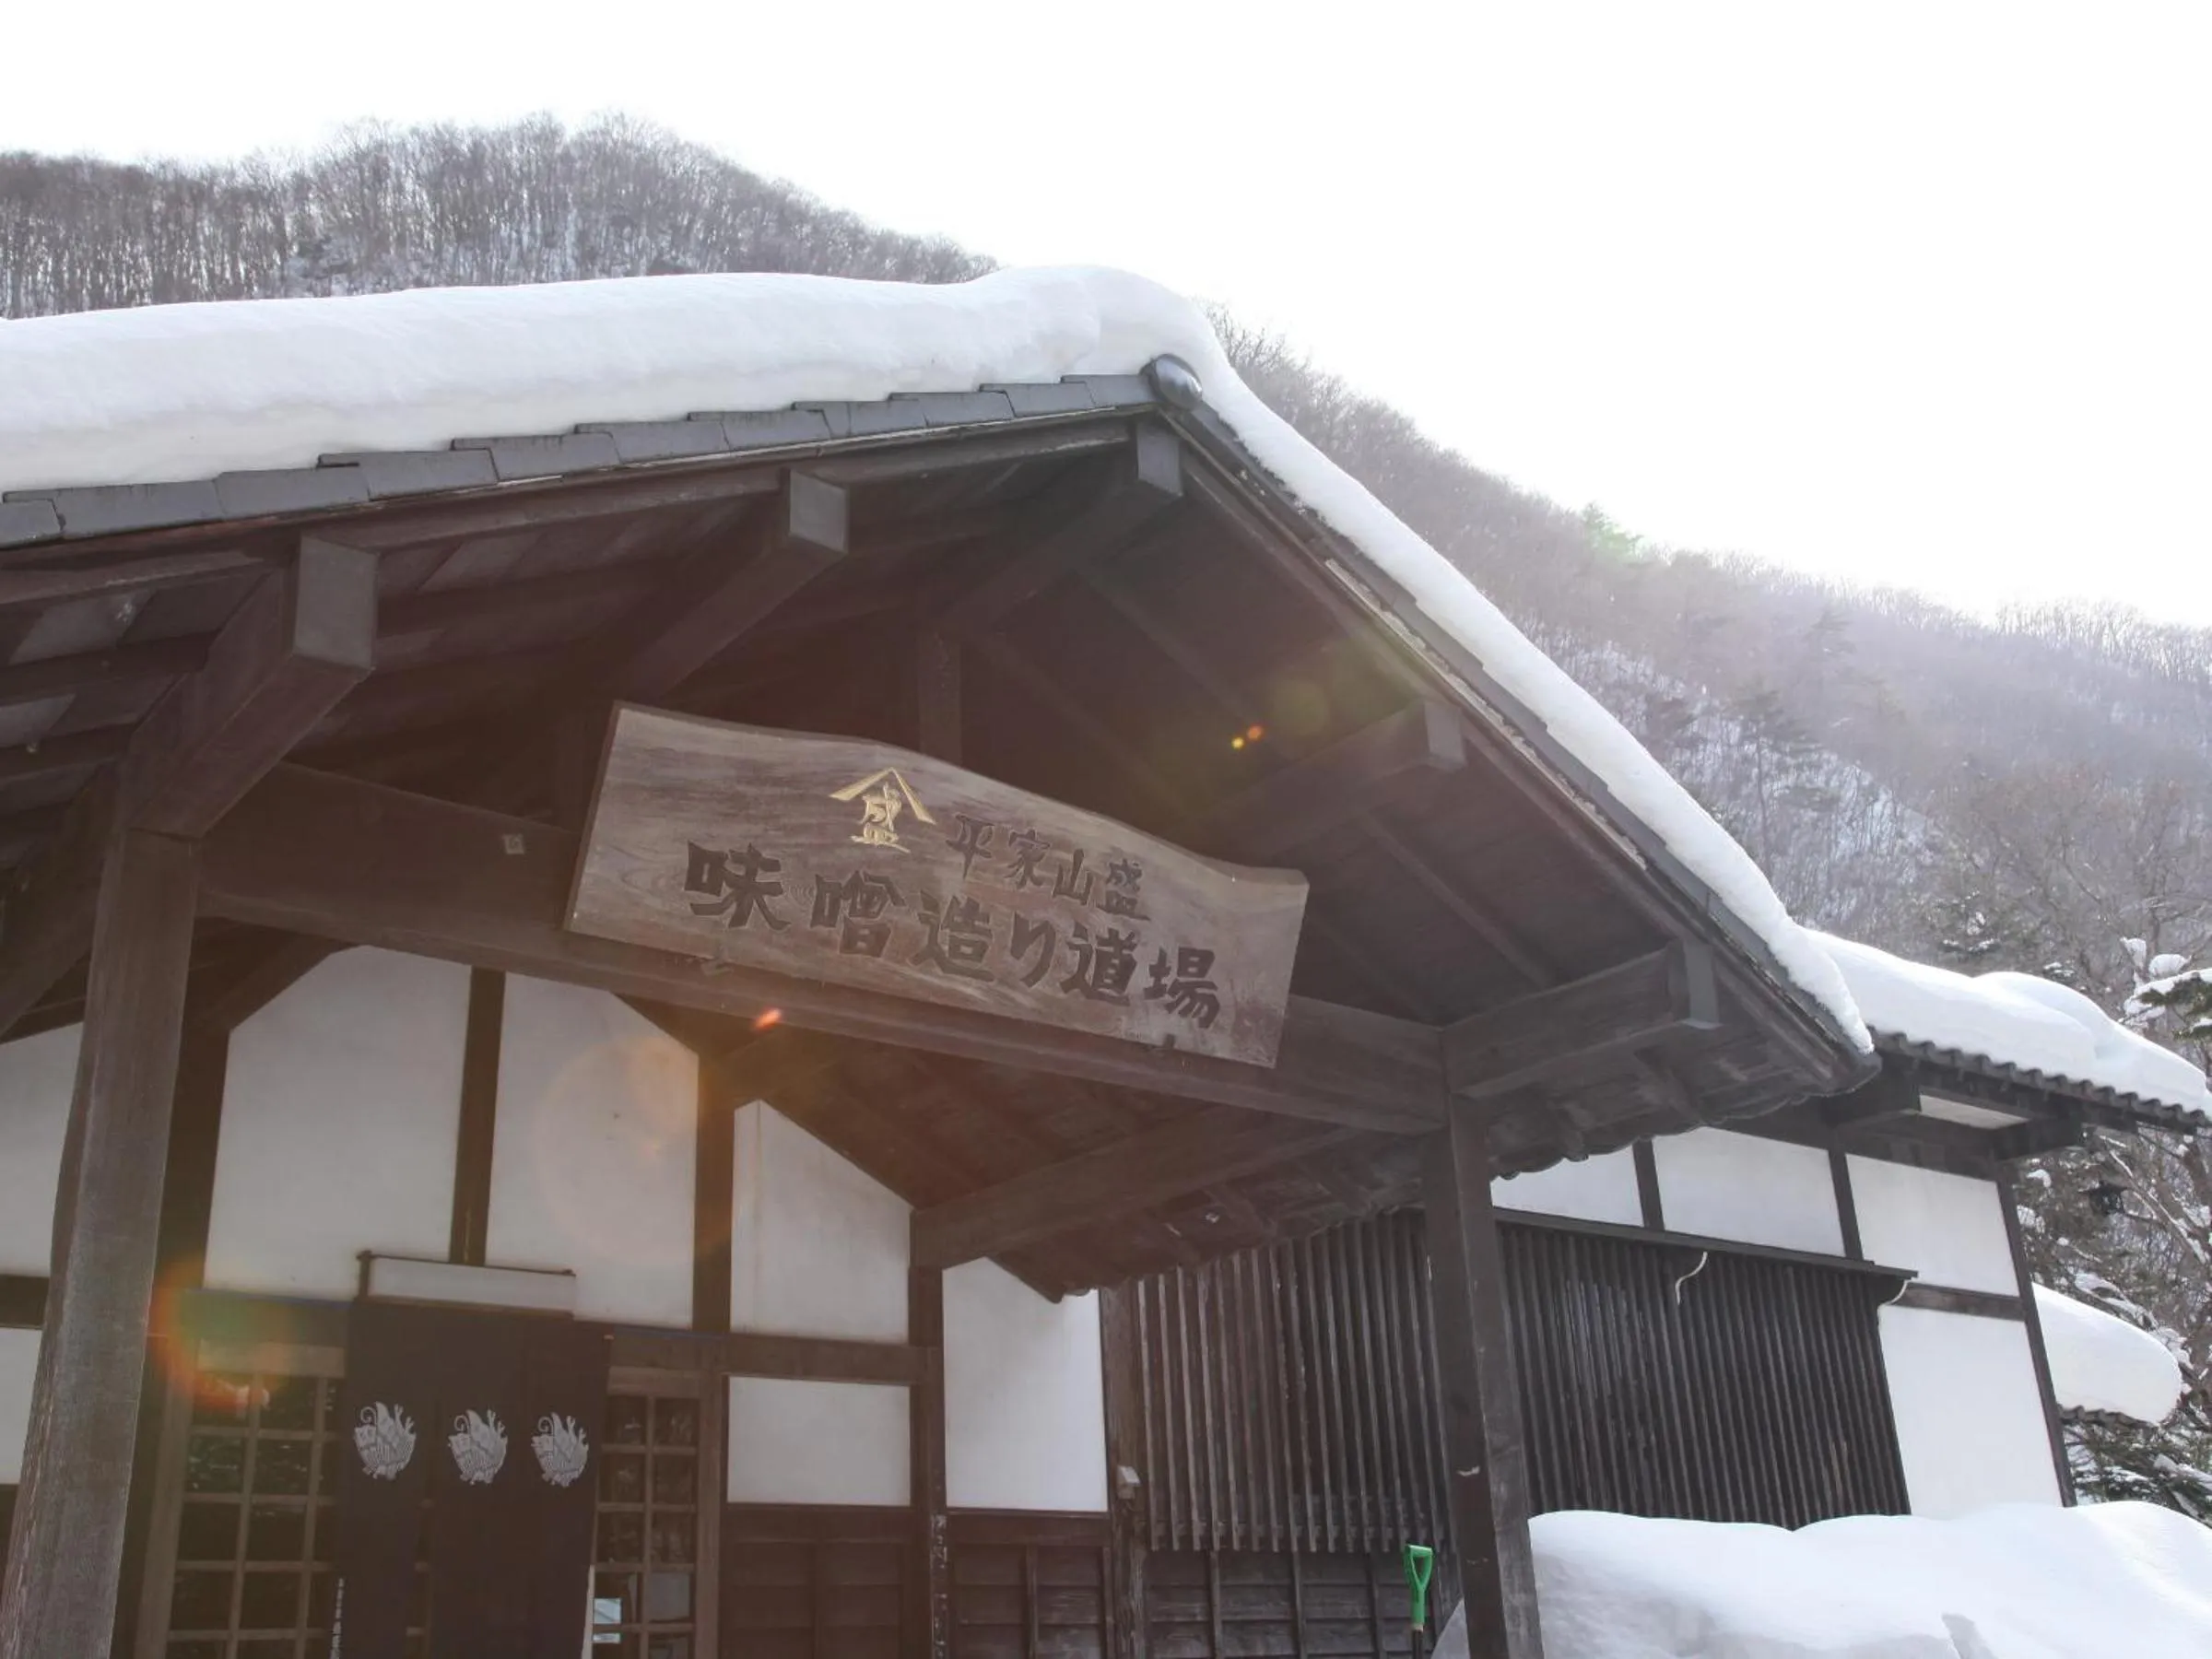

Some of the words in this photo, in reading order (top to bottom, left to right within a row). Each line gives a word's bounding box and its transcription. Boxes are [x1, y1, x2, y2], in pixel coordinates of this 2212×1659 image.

[684, 840, 1220, 1029] 味噌造り道場
